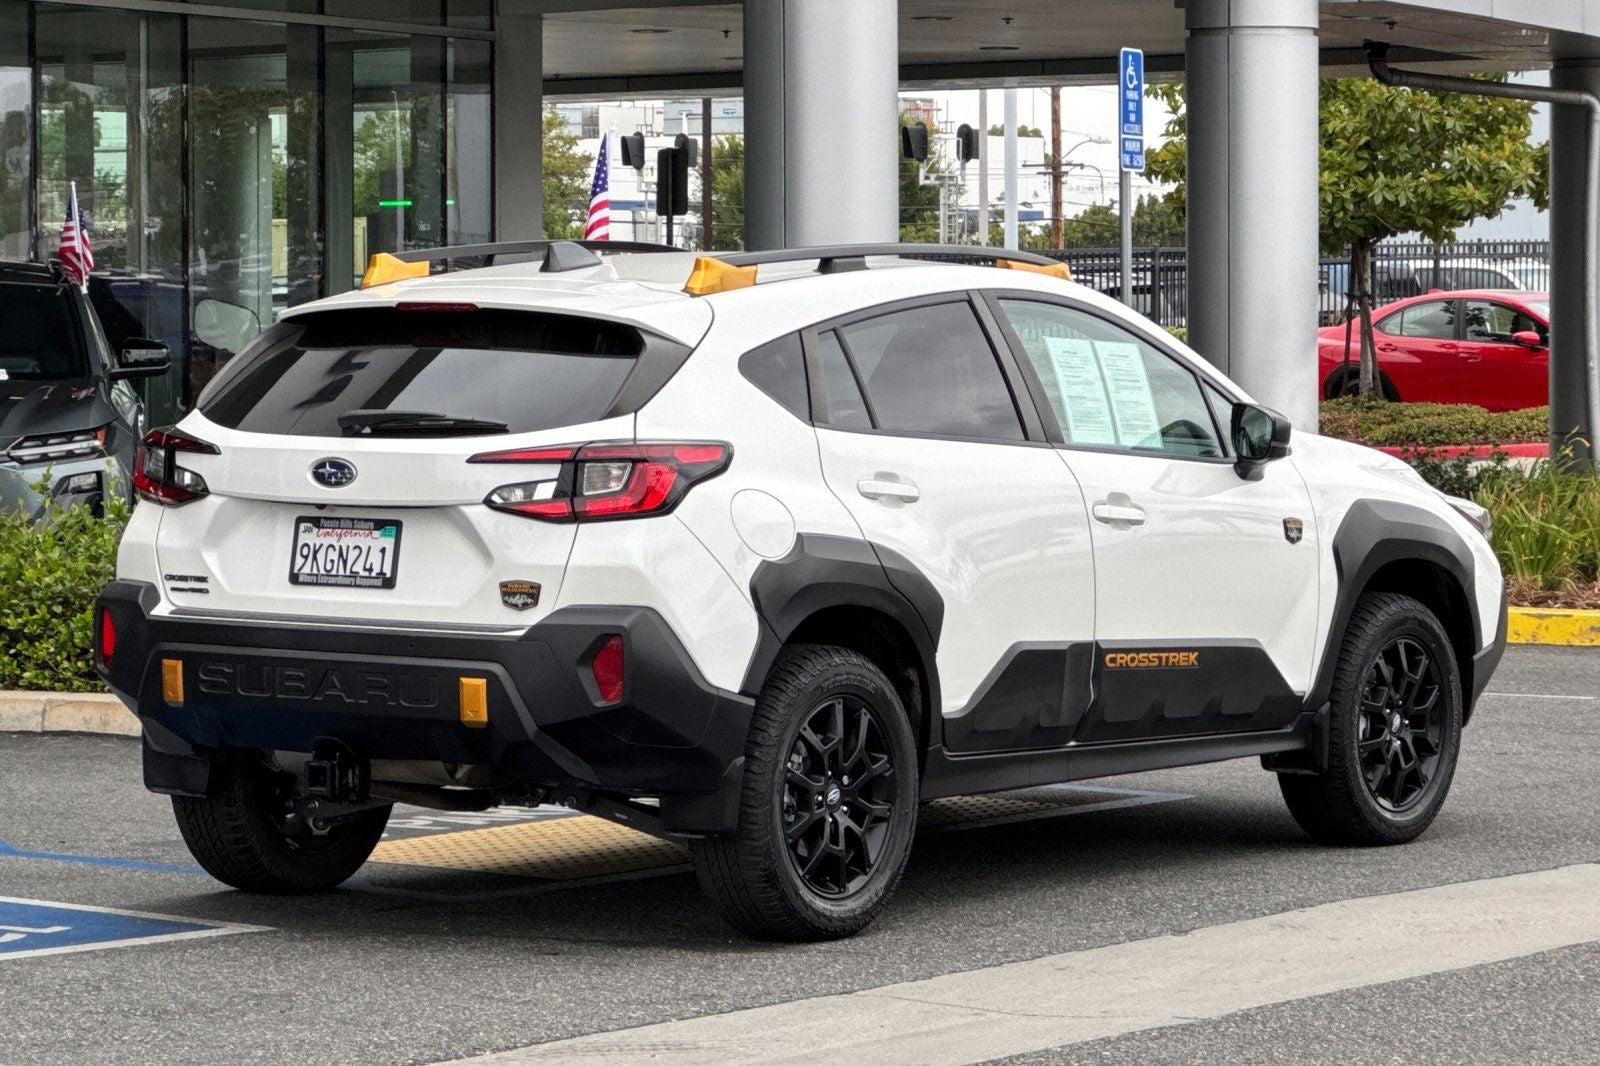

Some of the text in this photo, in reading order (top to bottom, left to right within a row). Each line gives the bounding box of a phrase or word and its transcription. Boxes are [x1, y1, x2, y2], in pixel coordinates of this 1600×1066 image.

[301, 525, 313, 534] JAN
[316, 527, 380, 543] California
[297, 542, 387, 576] 9KGN241
[164, 574, 208, 583] CROSSTREK
[299, 574, 317, 583] Where
[318, 575, 355, 585] Extraordinary
[1105, 652, 1199, 667] CROSSTREK
[199, 662, 440, 707] SUBARU
